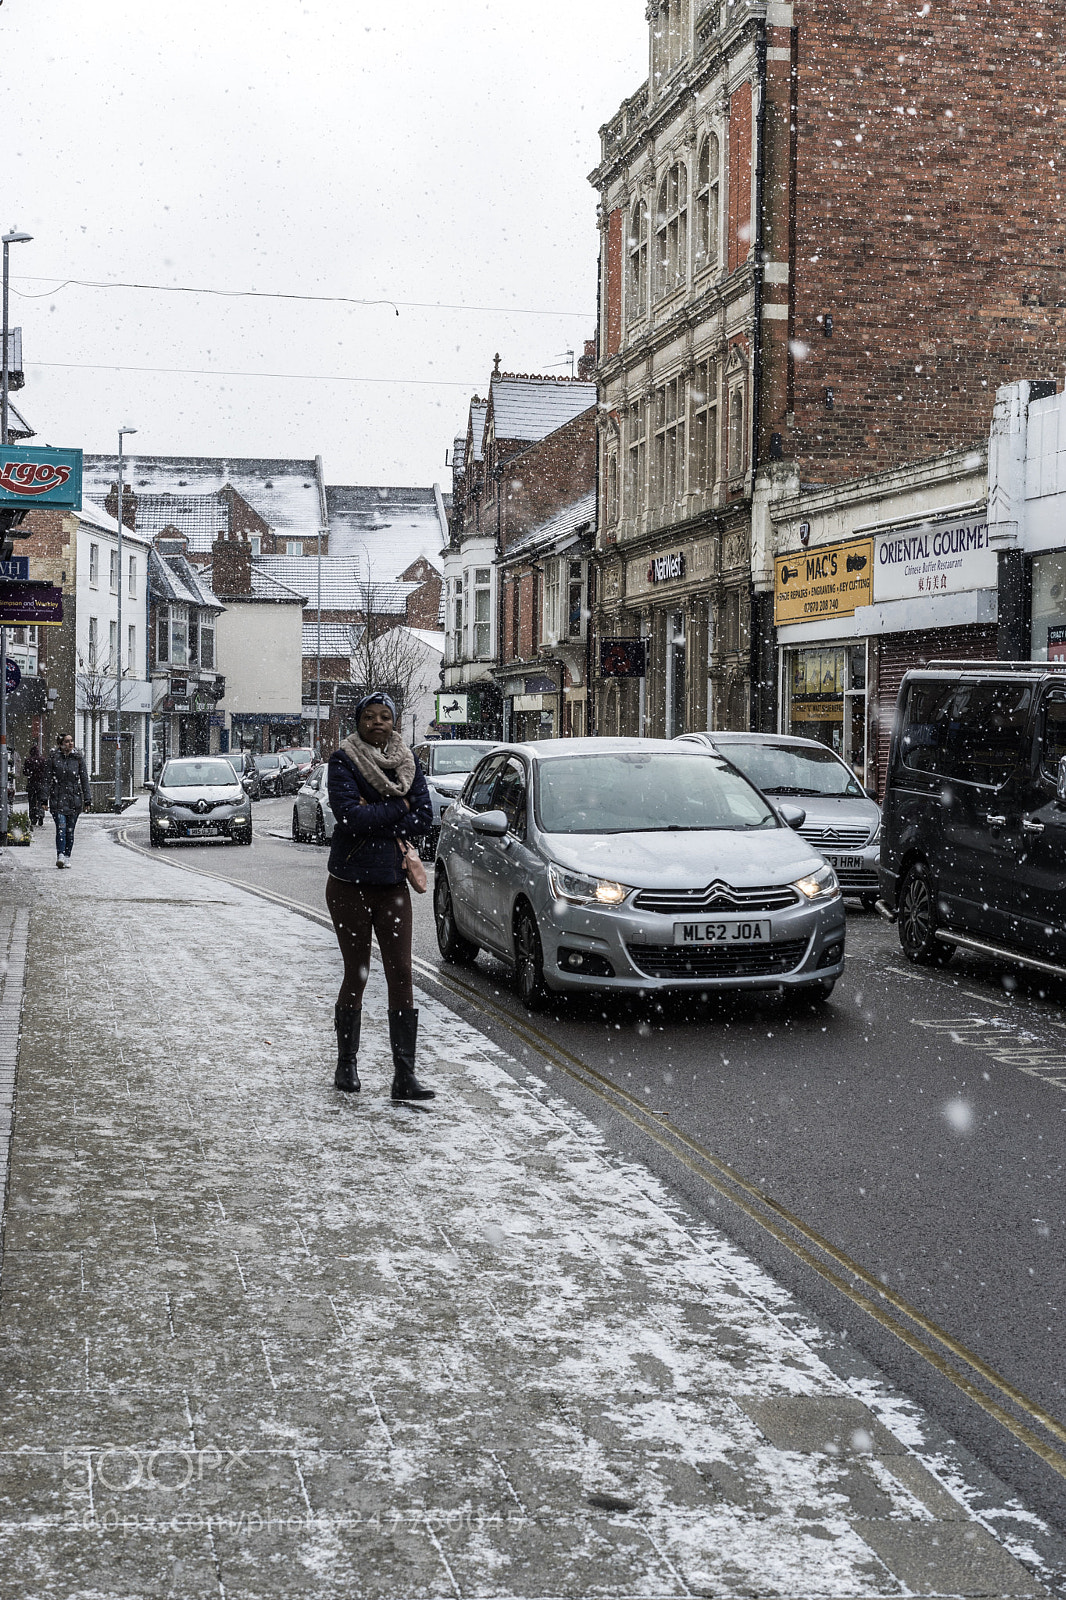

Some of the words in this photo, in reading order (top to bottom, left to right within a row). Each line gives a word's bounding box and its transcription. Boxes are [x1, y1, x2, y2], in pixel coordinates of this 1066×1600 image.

[879, 535, 930, 565] ORIENTAL
[933, 523, 989, 557] GOURMET
[654, 552, 681, 582] NatWest
[806, 552, 838, 582] MAC'S
[904, 563, 921, 576] Chinese
[922, 560, 937, 574] Buffet
[937, 558, 963, 571] Restaurant
[790, 588, 808, 600] REPAIRS
[811, 584, 836, 597] ENGRAVING
[839, 581, 849, 593] KEY
[848, 578, 870, 592] CUTTING
[918, 573, 947, 592] 東方美食
[840, 856, 861, 868] HRM
[683, 925, 727, 941] ML62
[732, 923, 762, 940] JOA
